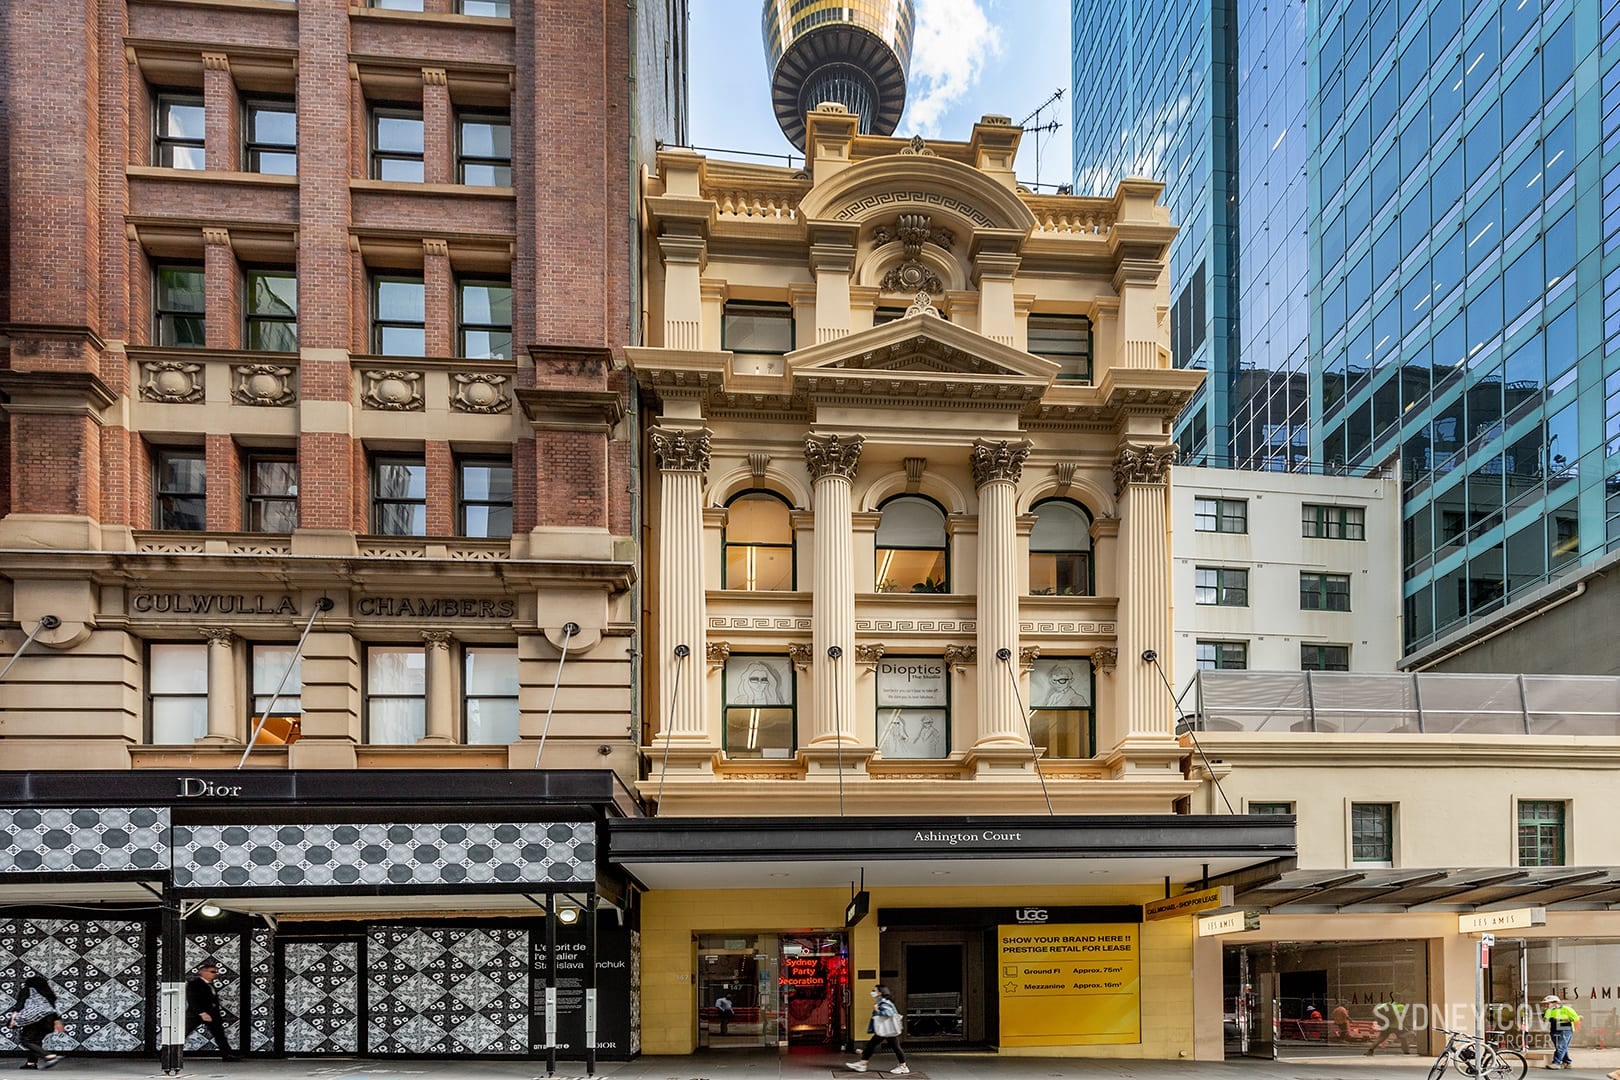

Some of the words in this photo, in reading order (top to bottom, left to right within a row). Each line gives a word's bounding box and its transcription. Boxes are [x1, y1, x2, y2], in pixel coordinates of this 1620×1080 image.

[133, 593, 298, 614] CULWULLA
[358, 597, 514, 618] CHAMBERS
[881, 664, 942, 682] Dioptics
[176, 777, 242, 797] Dior
[914, 831, 979, 845] Ashington
[982, 831, 1022, 841] Court
[1179, 900, 1192, 908] SHOP
[1192, 897, 1202, 905] FOR
[1202, 894, 1218, 903] LEASE
[1016, 910, 1048, 920] UGG
[1473, 918, 1488, 927] LES
[1492, 915, 1515, 925] AMIS
[1207, 921, 1218, 930] LES
[1219, 918, 1235, 928] AMIS
[572, 943, 587, 951] de
[1049, 945, 1081, 953] RETAIL
[1102, 944, 1132, 952] LEASE
[785, 958, 818, 967] Sydney
[792, 967, 816, 976] Party
[1073, 967, 1102, 975] Approx.
[1073, 982, 1102, 990] Approx.
[1351, 991, 1395, 1005] AMIS
